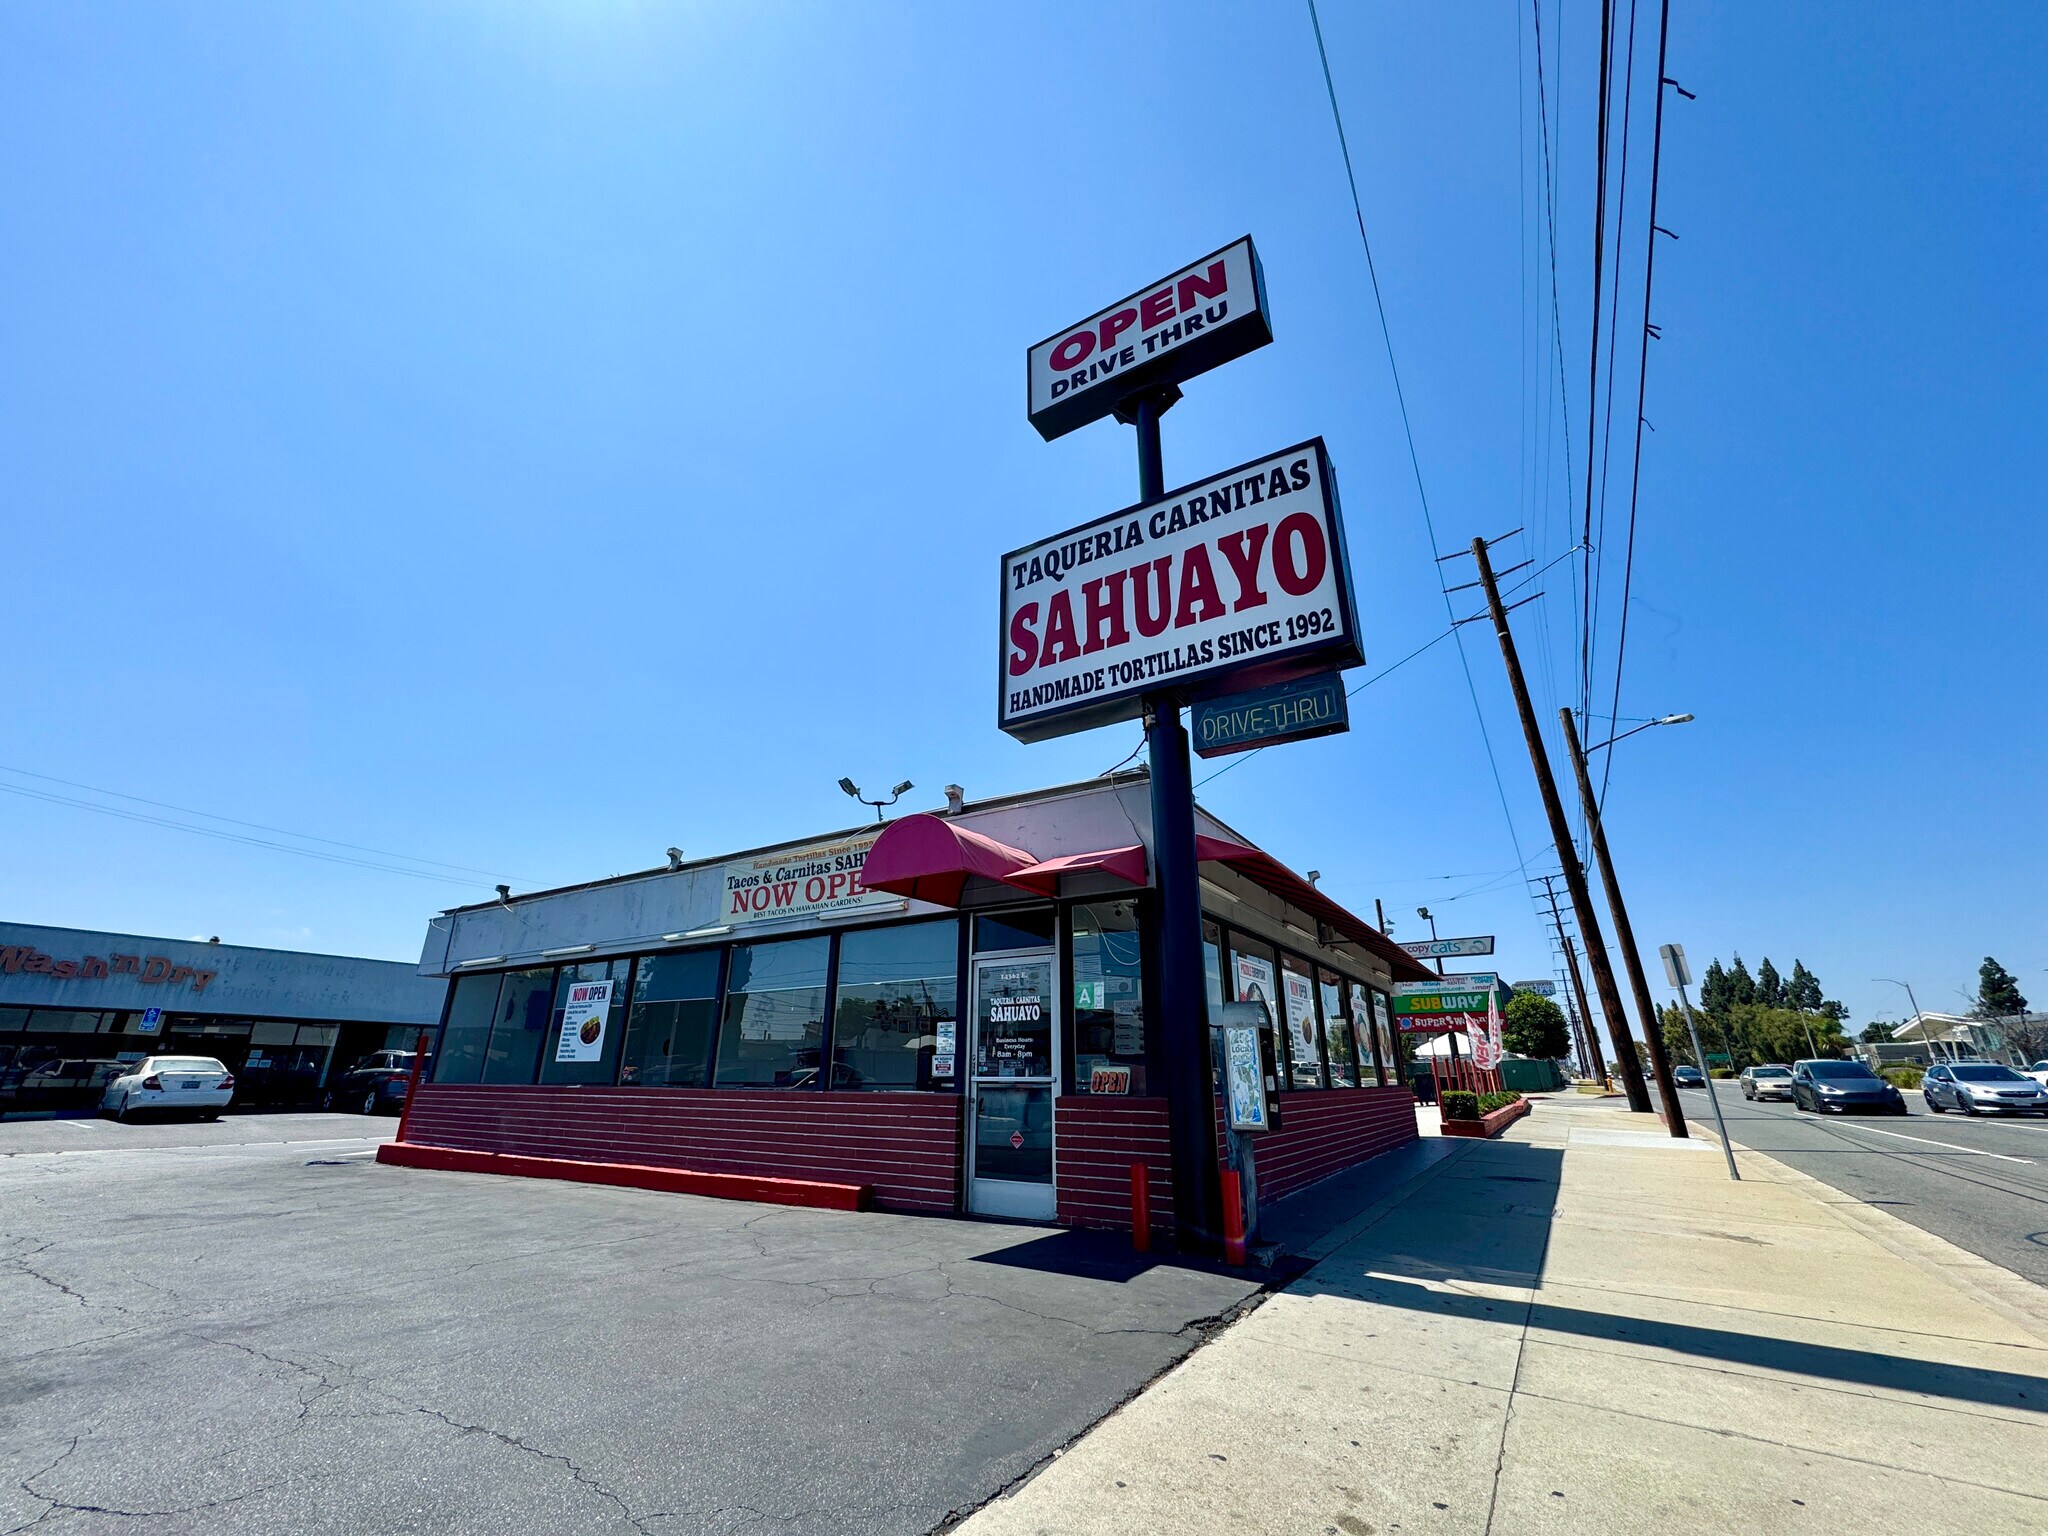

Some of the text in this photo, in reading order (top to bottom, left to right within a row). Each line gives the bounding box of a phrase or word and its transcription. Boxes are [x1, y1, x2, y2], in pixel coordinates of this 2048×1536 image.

[1048, 259, 1229, 372] OPEN
[1050, 301, 1228, 400] DRIVE THRU
[1012, 459, 1311, 591] TAQUERIA CARNITAS
[1008, 512, 1327, 677] SAHUAYO
[1009, 607, 1335, 714] HANDMADE TORTILLAS SINCE 1992
[1202, 694, 1331, 742] DRIVE-THRU
[753, 855, 792, 870] Handmade
[793, 850, 827, 863] Tortillas
[828, 846, 851, 857] Since
[727, 874, 760, 890] Tacos
[763, 871, 773, 884] &
[775, 860, 831, 881] Carnitas
[730, 869, 880, 914] NOW OPE
[753, 896, 863, 919] BEST TACOS IN HAWAIIAN GARDENS!
[0, 944, 109, 979] Wash
[139, 955, 217, 991] Dry
[573, 985, 607, 1001] NOW OPEN
[990, 995, 1040, 1006] TAQUERIA CARNITAS
[1079, 988, 1091, 1004] A
[1409, 994, 1483, 1011] SUBWAY
[990, 1005, 1040, 1022] SAHUAYO
[1414, 1017, 1446, 1028] SUPER
[997, 1050, 1011, 1058] 8am
[1017, 1050, 1033, 1059] 8pm
[1091, 1070, 1129, 1093] OPEN
